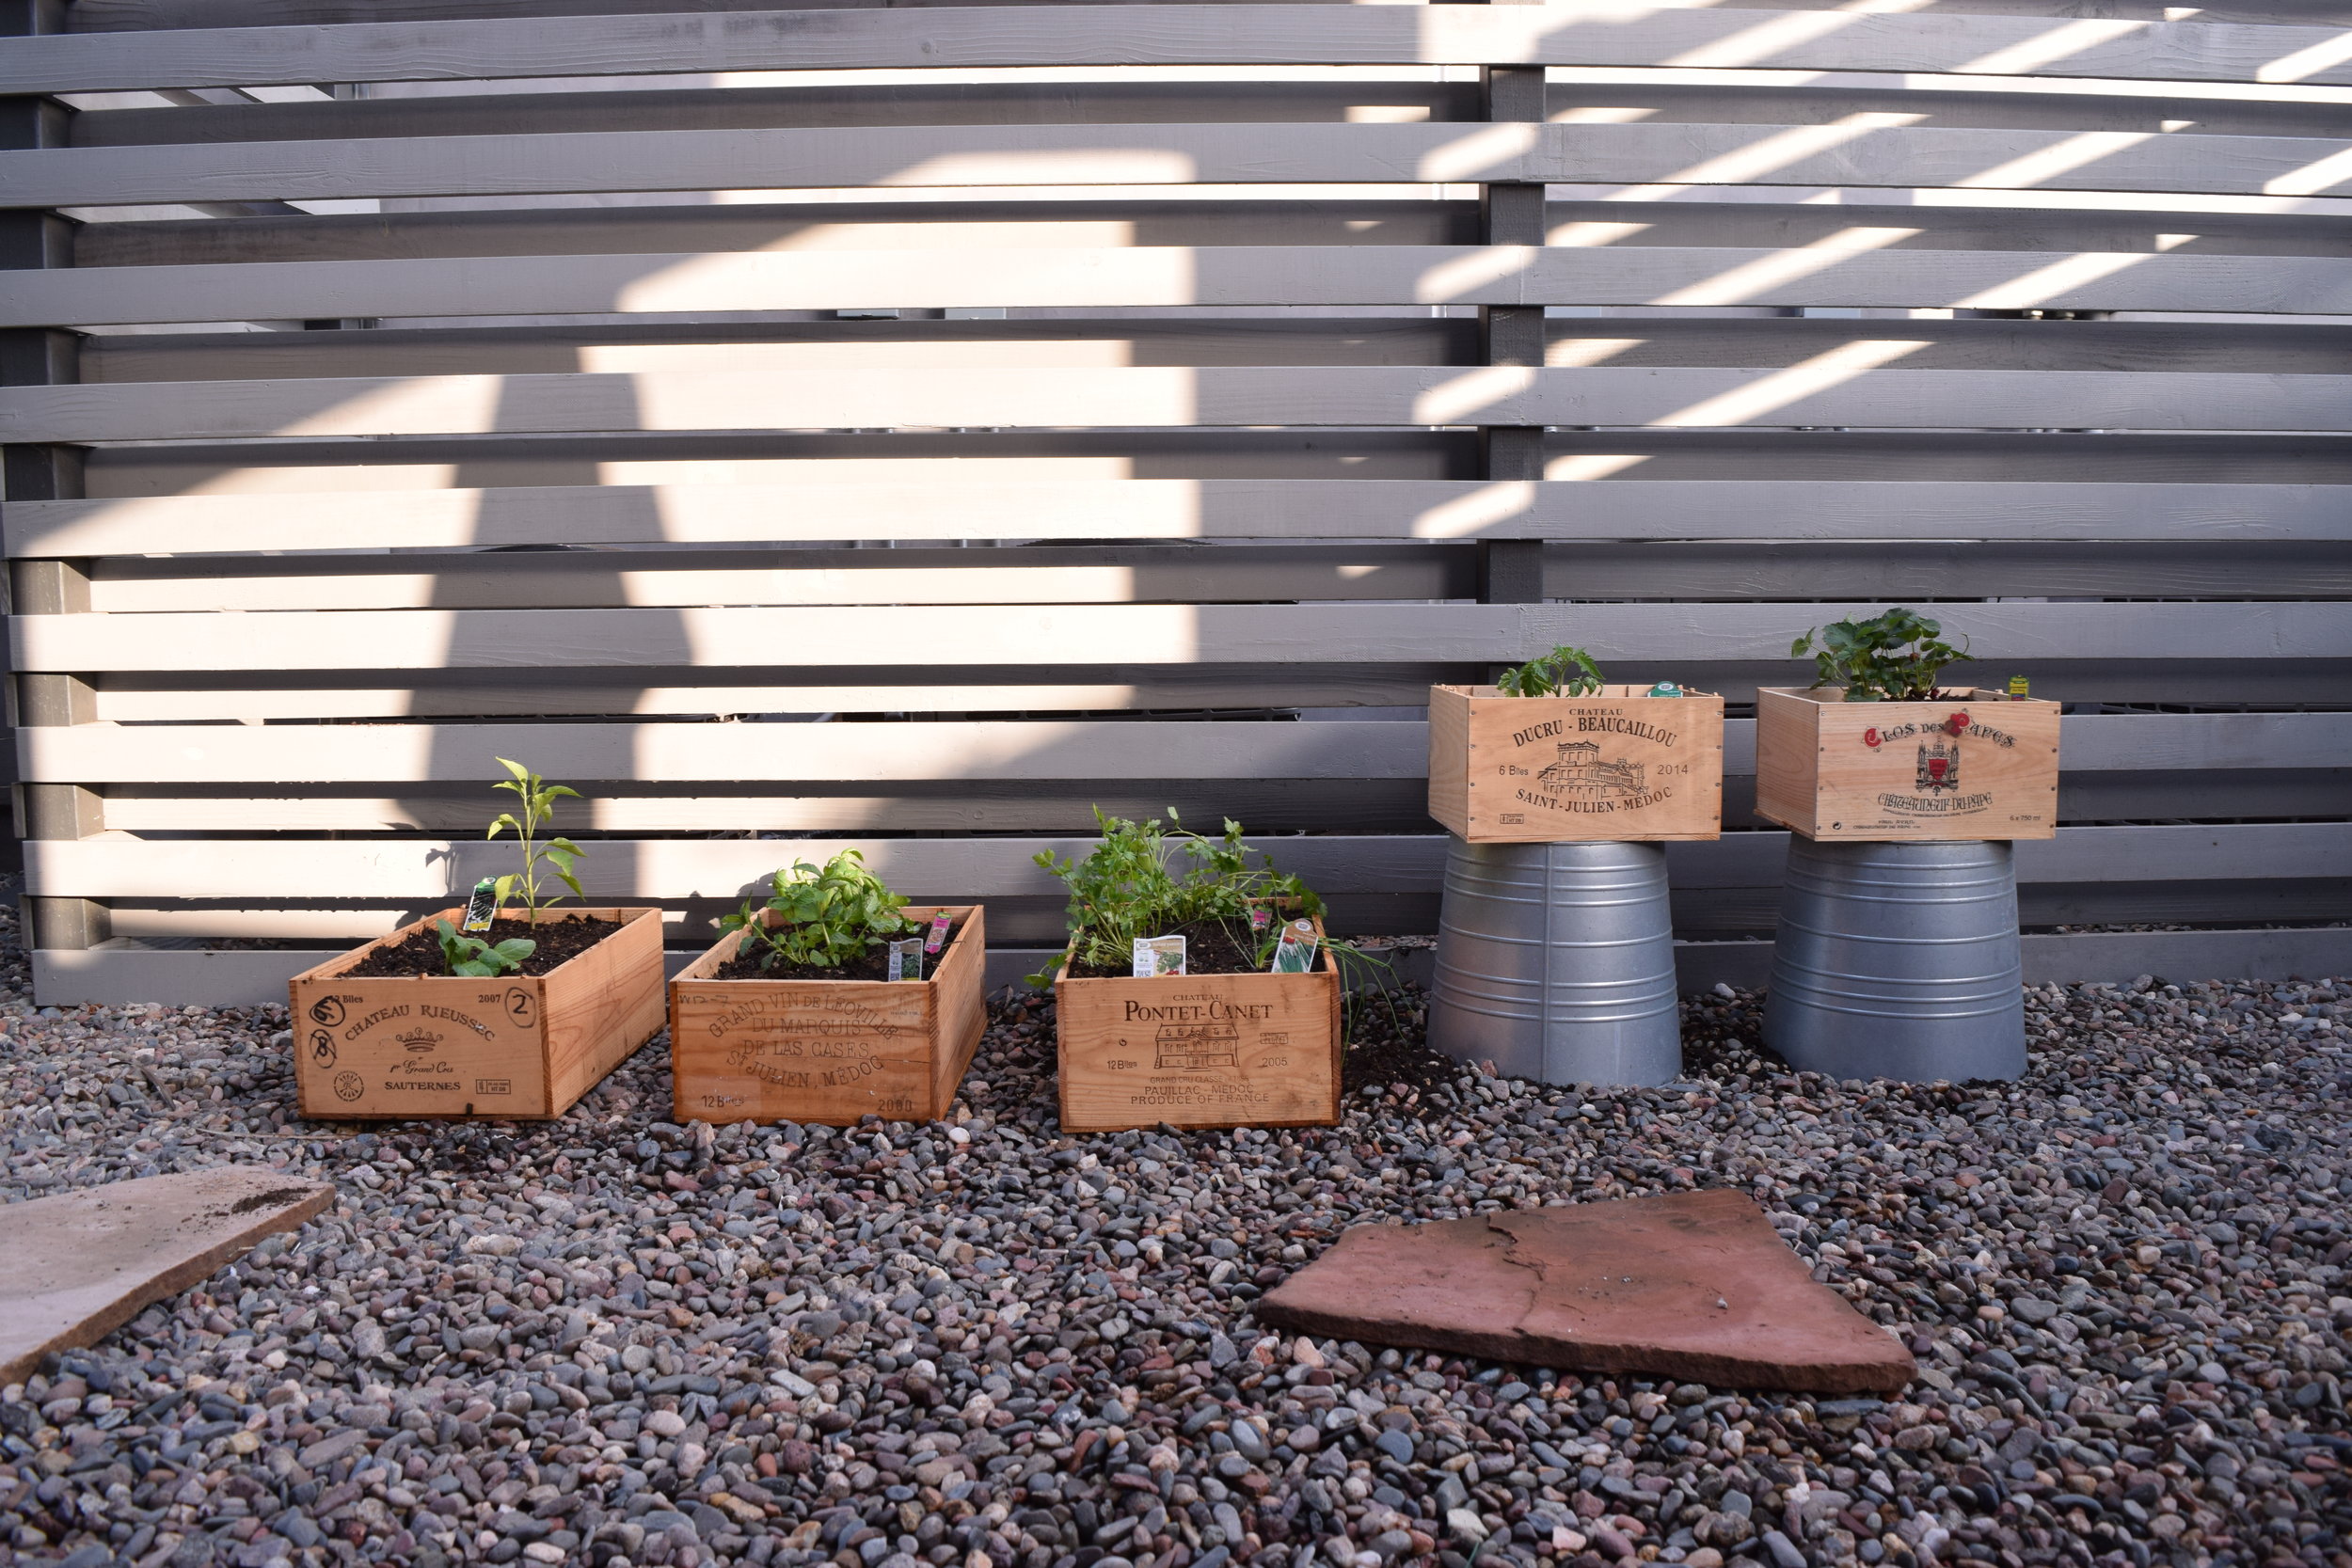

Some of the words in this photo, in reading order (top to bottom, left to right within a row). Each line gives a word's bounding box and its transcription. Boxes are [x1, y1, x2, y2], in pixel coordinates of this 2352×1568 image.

[1513, 720, 1563, 748] DUCRU
[1578, 717, 1677, 748] BEAUCAILLOU
[1499, 765, 1505, 775] 6
[1657, 764, 1689, 775] 2014
[478, 994, 501, 1004] 2007
[708, 999, 765, 1038] GRAND
[769, 992, 799, 1009] VIN
[803, 996, 821, 1008] DE
[345, 1005, 410, 1041] CHATEAU
[421, 1005, 495, 1041] RIEUSSEC
[753, 1018, 774, 1033] DU
[780, 1018, 861, 1036] MARQUIS
[743, 1039, 766, 1055] DE
[773, 1040, 803, 1056] LAS
[811, 1042, 869, 1058] CASES
[403, 1059, 435, 1074] Grand
[437, 1061, 453, 1073] Cru
[1262, 1056, 1288, 1067] 2005
[384, 1081, 461, 1091] SAUTERNES
[1145, 1085, 1200, 1096] PAUILLAC
[701, 1095, 715, 1108] 12
[1131, 1095, 1192, 1105] PRODUCE
[1197, 1094, 1214, 1104] OF
[1218, 1093, 1270, 1103] FRANCE
